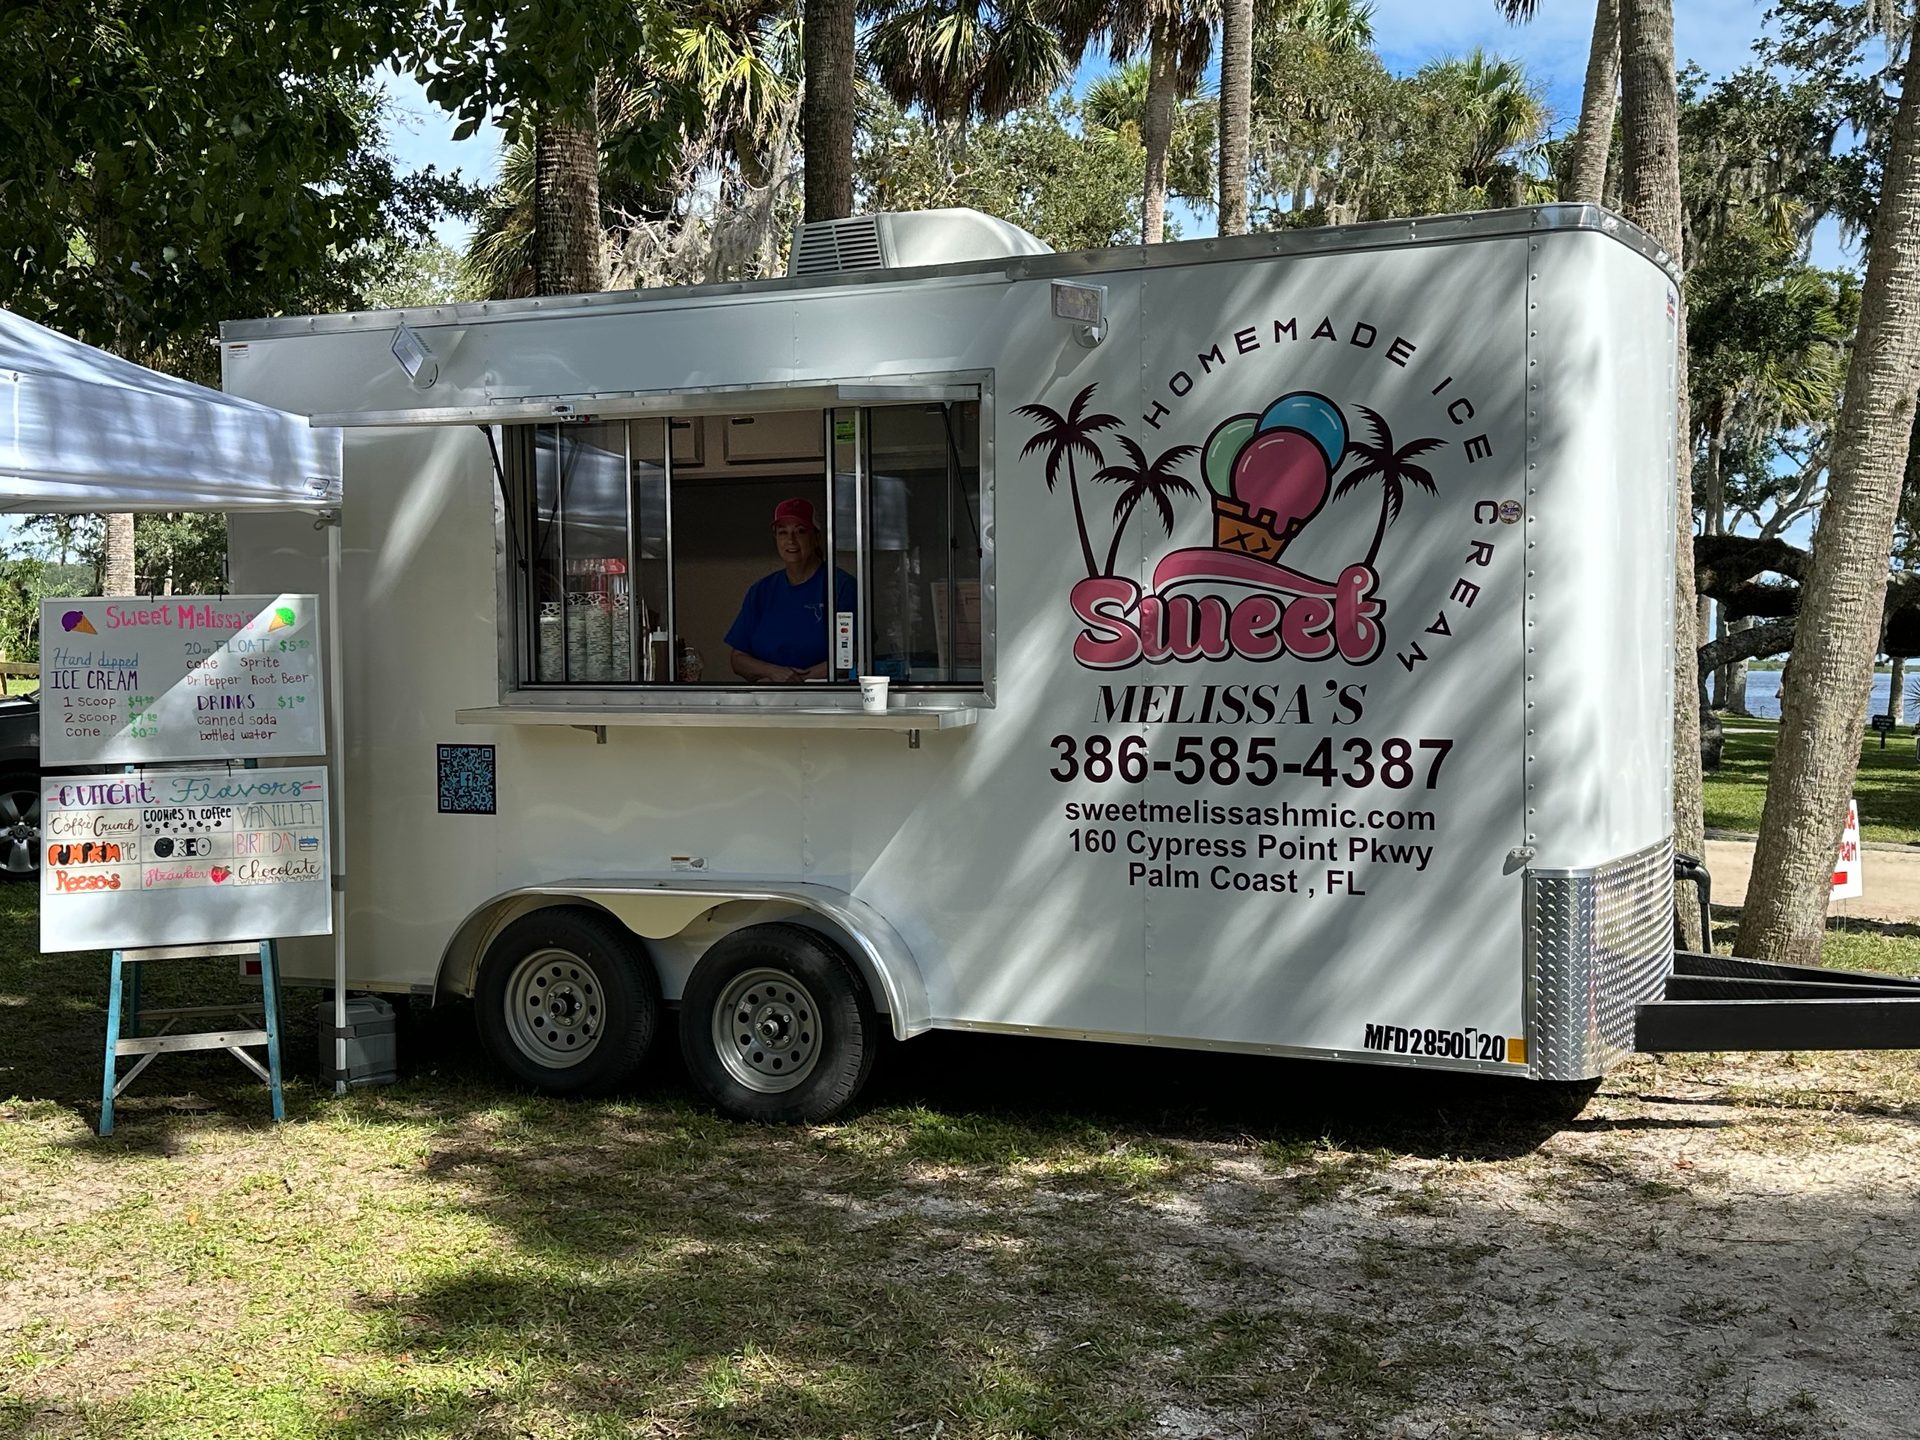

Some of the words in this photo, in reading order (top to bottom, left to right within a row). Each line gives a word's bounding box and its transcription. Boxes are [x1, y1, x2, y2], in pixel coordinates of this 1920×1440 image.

[1142, 317, 1417, 430] HOMEMADE
[1431, 376, 1494, 465] ICE
[1397, 500, 1499, 673] CREAM
[106, 604, 172, 629] Sweet
[178, 604, 255, 630] Melissa's
[1069, 562, 1388, 671] Sweet
[214, 639, 270, 653] FLOAT
[53, 648, 92, 667] Hand
[97, 652, 139, 670] dipped
[240, 657, 280, 671] Sprite
[50, 670, 80, 689] ICE
[87, 669, 138, 691] CREAM
[204, 674, 240, 689] Pepper
[251, 673, 277, 685] Root
[281, 672, 309, 685] Beer
[63, 696, 74, 708] 1
[197, 694, 255, 710] DRINKS
[1091, 679, 1369, 725] MELISSA'S
[63, 712, 75, 723] 2
[197, 713, 244, 727] canned
[199, 729, 235, 741] bottled
[240, 729, 277, 740] water
[1049, 734, 1455, 790] 386-585-4387
[169, 778, 312, 803] Flavors
[93, 815, 139, 837] Crunch
[236, 803, 315, 828] VANILLA
[1064, 799, 1436, 831] sweetmelissashmic.com
[154, 837, 212, 858] OREO
[236, 831, 297, 855] BIRTHDAY
[1069, 828, 1116, 854] 160
[1126, 830, 1247, 862] Cypress
[1258, 834, 1338, 862] Point
[1348, 838, 1434, 871] Pkwy
[1128, 863, 1199, 889] Palm
[1327, 870, 1366, 896] FL
[1363, 1023, 1506, 1062] MFD2850120
